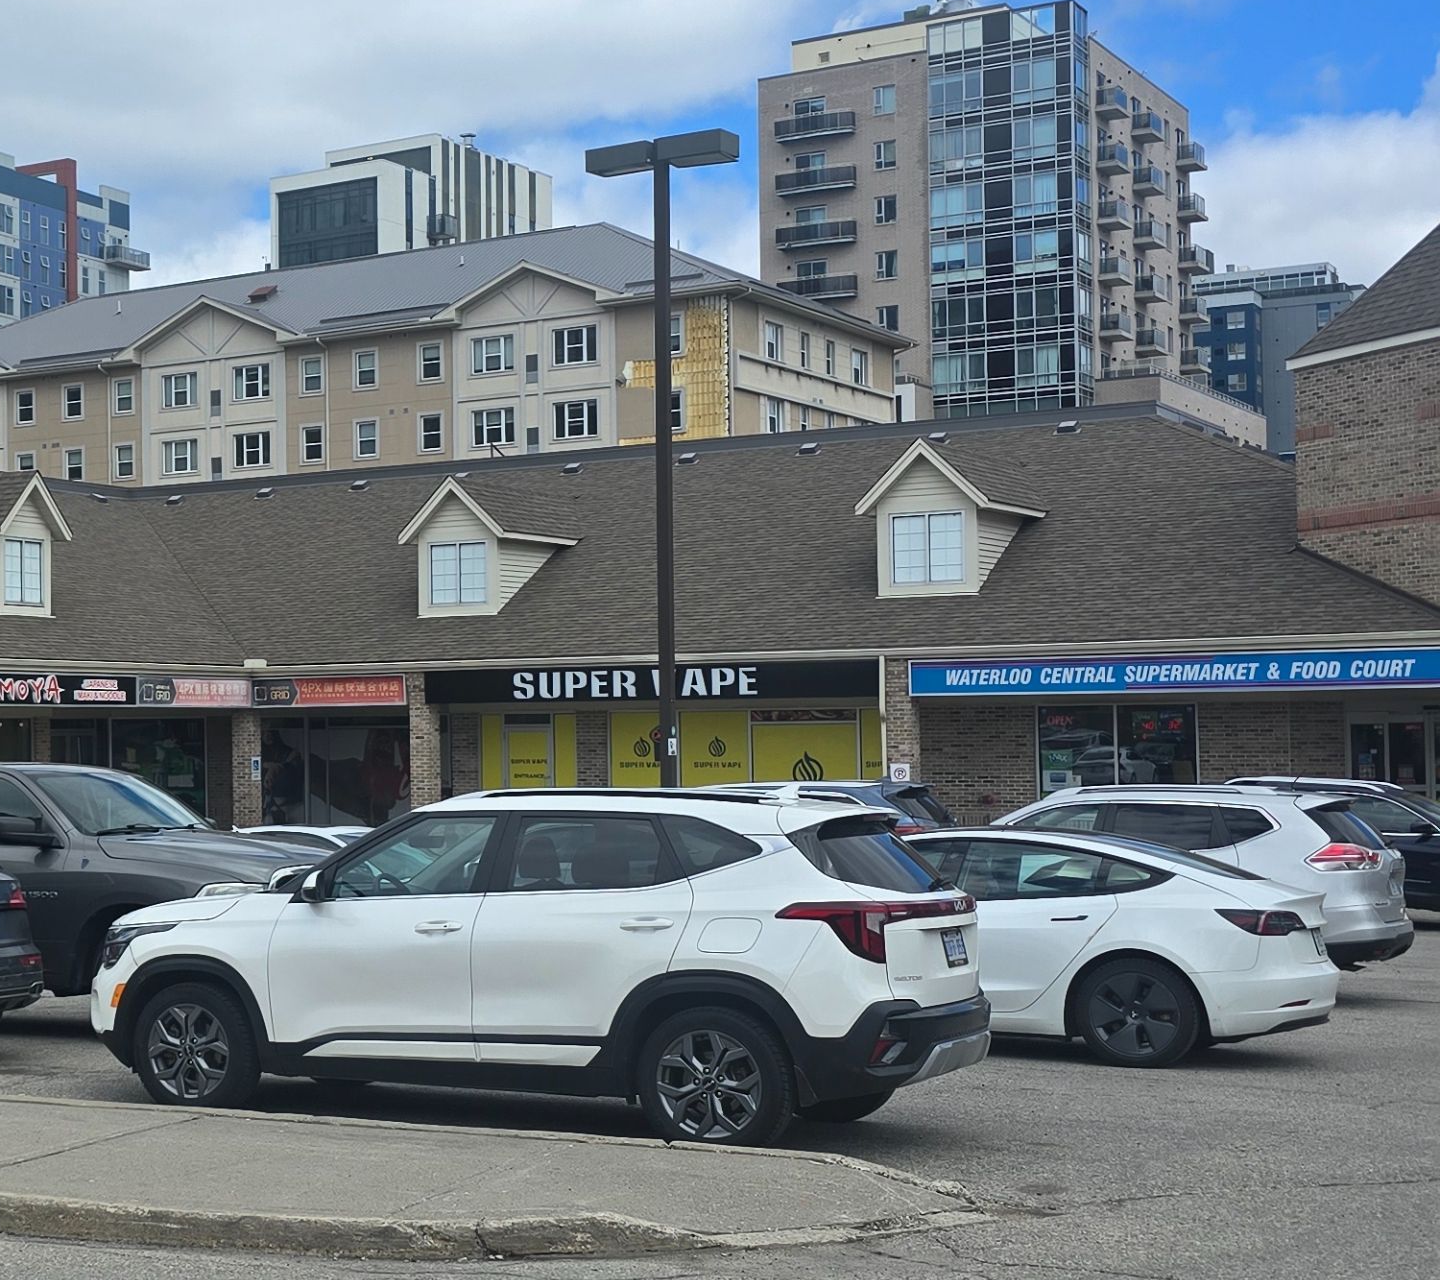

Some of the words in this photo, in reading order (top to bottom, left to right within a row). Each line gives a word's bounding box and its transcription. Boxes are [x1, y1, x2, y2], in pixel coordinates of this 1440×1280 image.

[513, 670, 637, 700] SUPER
[946, 668, 1032, 686] WATERLOO
[1040, 666, 1116, 684] CENTRAL
[1124, 663, 1259, 683] SUPERMARKET
[1266, 662, 1280, 680] &
[1289, 661, 1341, 679] FOOD
[1350, 658, 1416, 678] COURT
[693, 761, 720, 769] SUPER
[721, 761, 742, 769] VAPE
